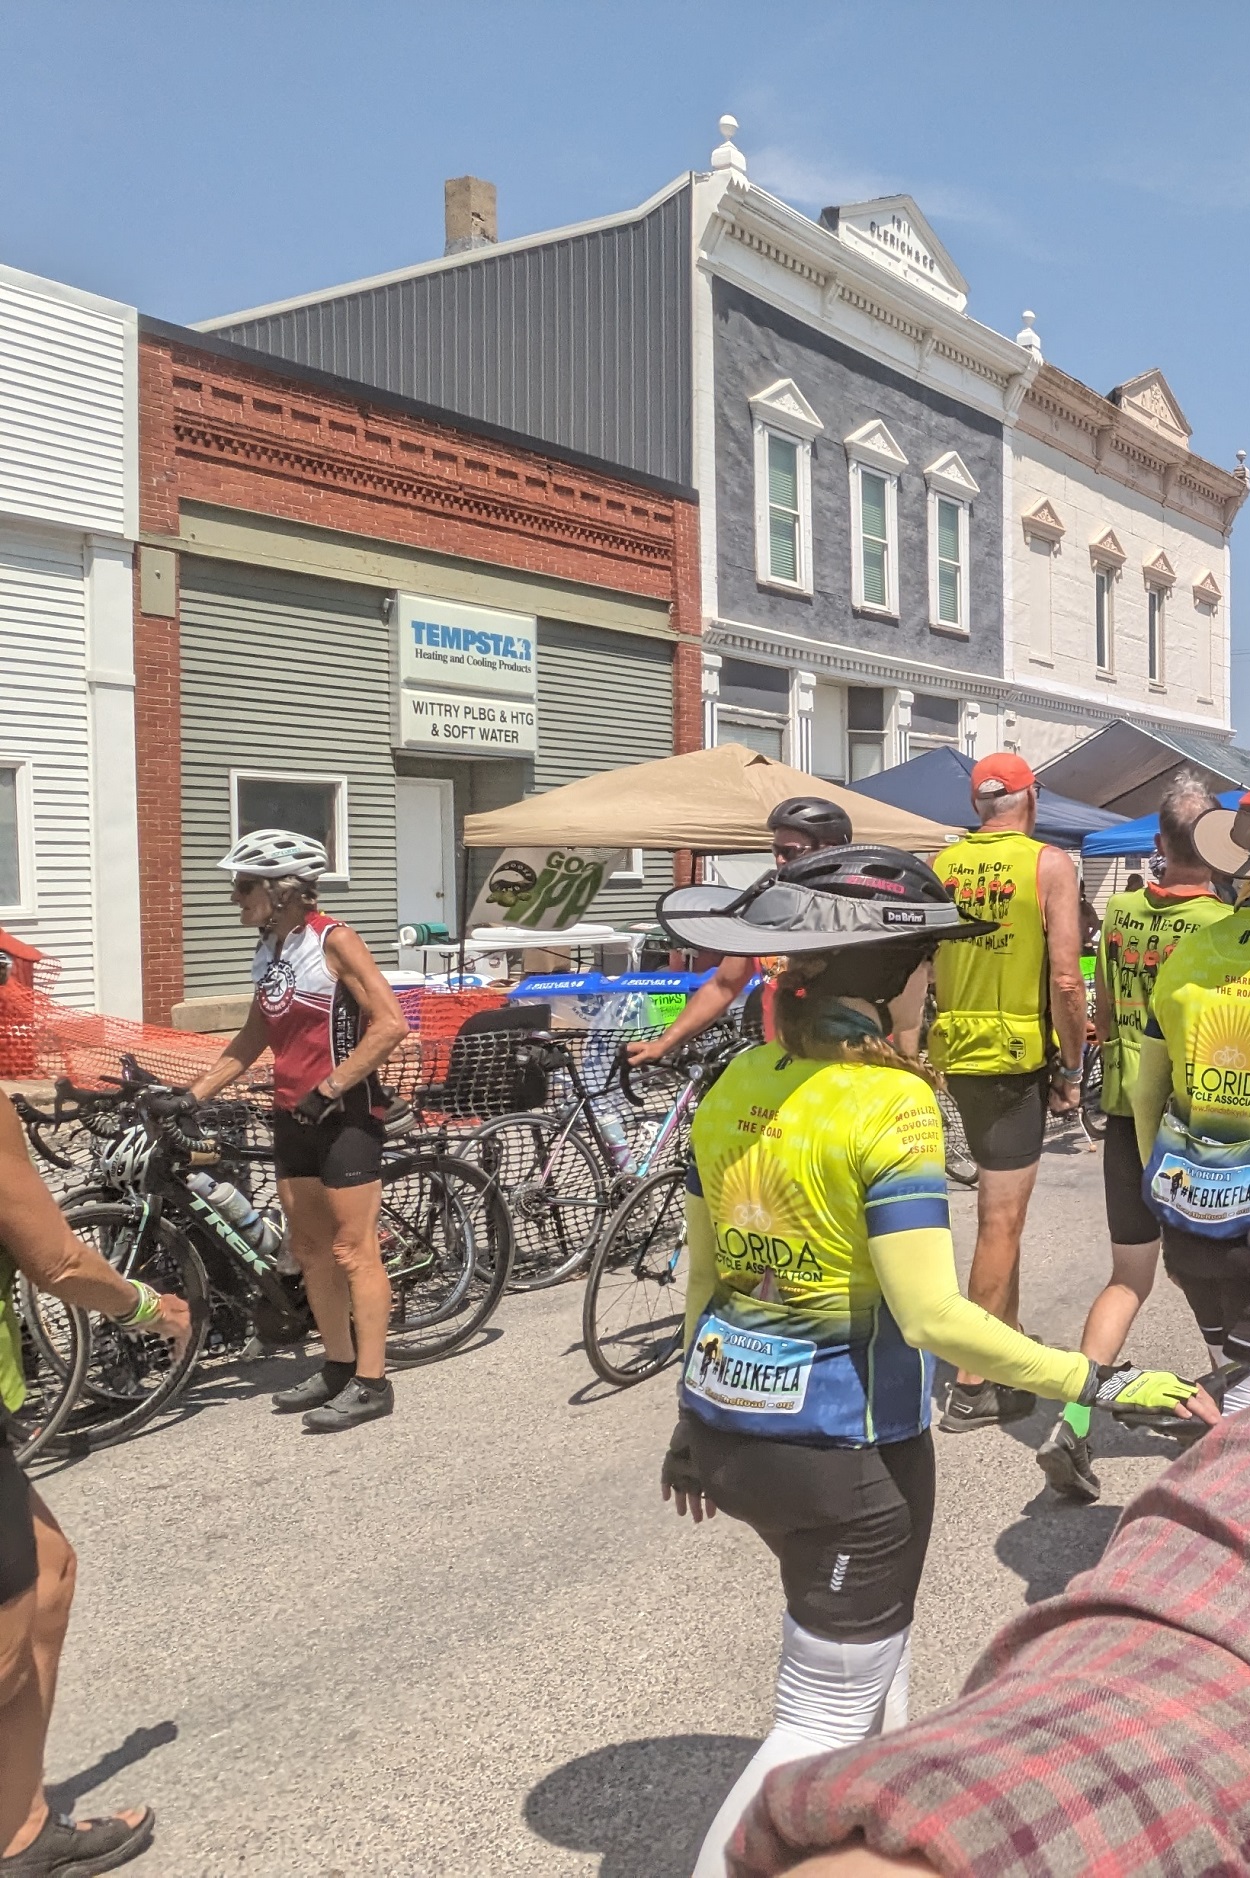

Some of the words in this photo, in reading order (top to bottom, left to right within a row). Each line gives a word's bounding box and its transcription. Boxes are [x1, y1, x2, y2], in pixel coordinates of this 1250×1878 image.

[411, 620, 531, 661] TEMPSTAR
[415, 648, 448, 664] Heating
[450, 655, 464, 664] and
[467, 656, 497, 671] Cooling
[499, 660, 531, 673] Products
[413, 700, 460, 718] WITTRY
[464, 706, 495, 721] PLBG
[500, 710, 507, 723] &
[511, 712, 534, 726] HTG
[431, 723, 439, 737] &
[444, 724, 475, 740] SOFT
[479, 728, 519, 743] WATER
[1216, 985, 1231, 996] THE
[895, 1106, 936, 1122] MOBILIZE
[738, 1120, 757, 1133] THE
[760, 1125, 782, 1139] ROAD
[896, 1119, 939, 1134] ADVOCATE
[902, 1132, 939, 1145] EDUCATE
[189, 1191, 271, 1276] TREK
[714, 1222, 822, 1270] LORIDA
